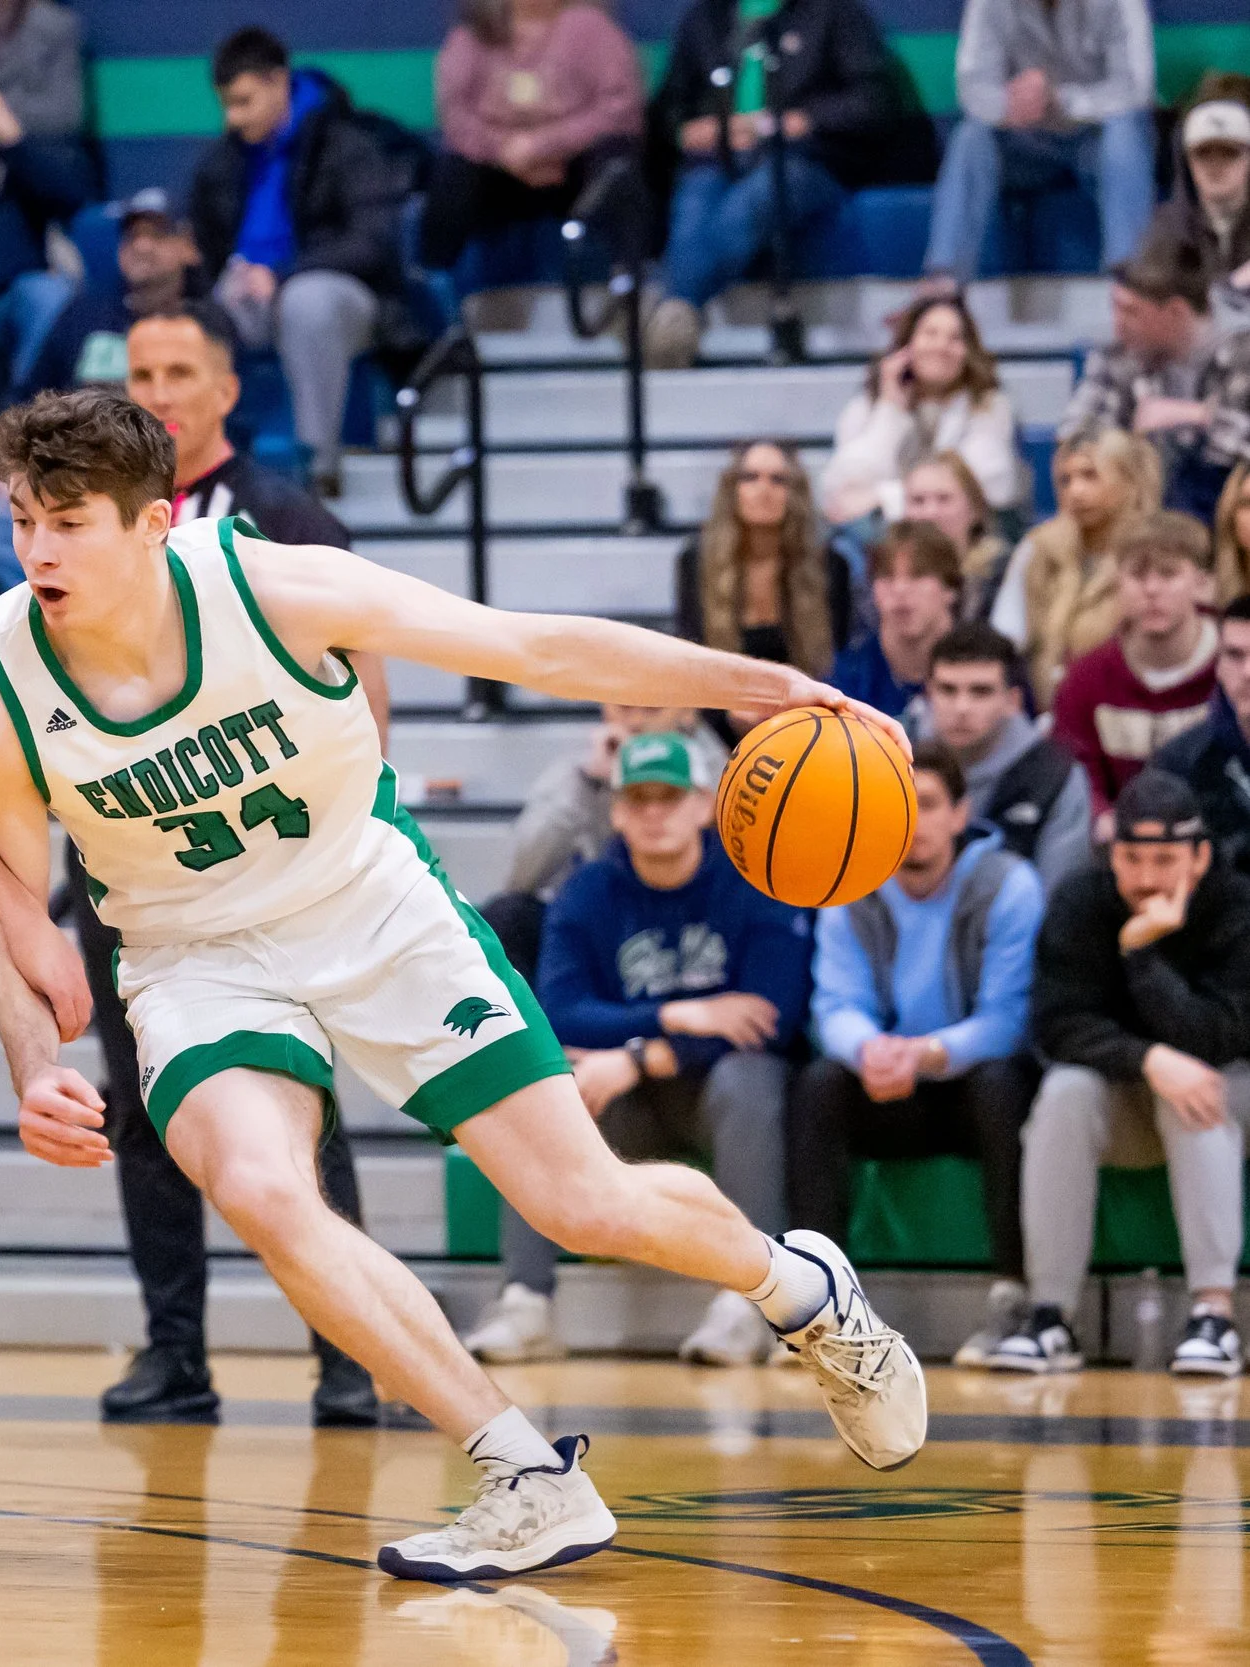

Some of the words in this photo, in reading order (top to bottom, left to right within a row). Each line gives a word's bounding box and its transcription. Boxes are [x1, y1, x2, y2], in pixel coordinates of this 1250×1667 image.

[45, 719, 78, 734] adidas
[74, 699, 300, 820] ENDICOTT
[152, 782, 311, 873] 34
[730, 754, 786, 874] Wilson
